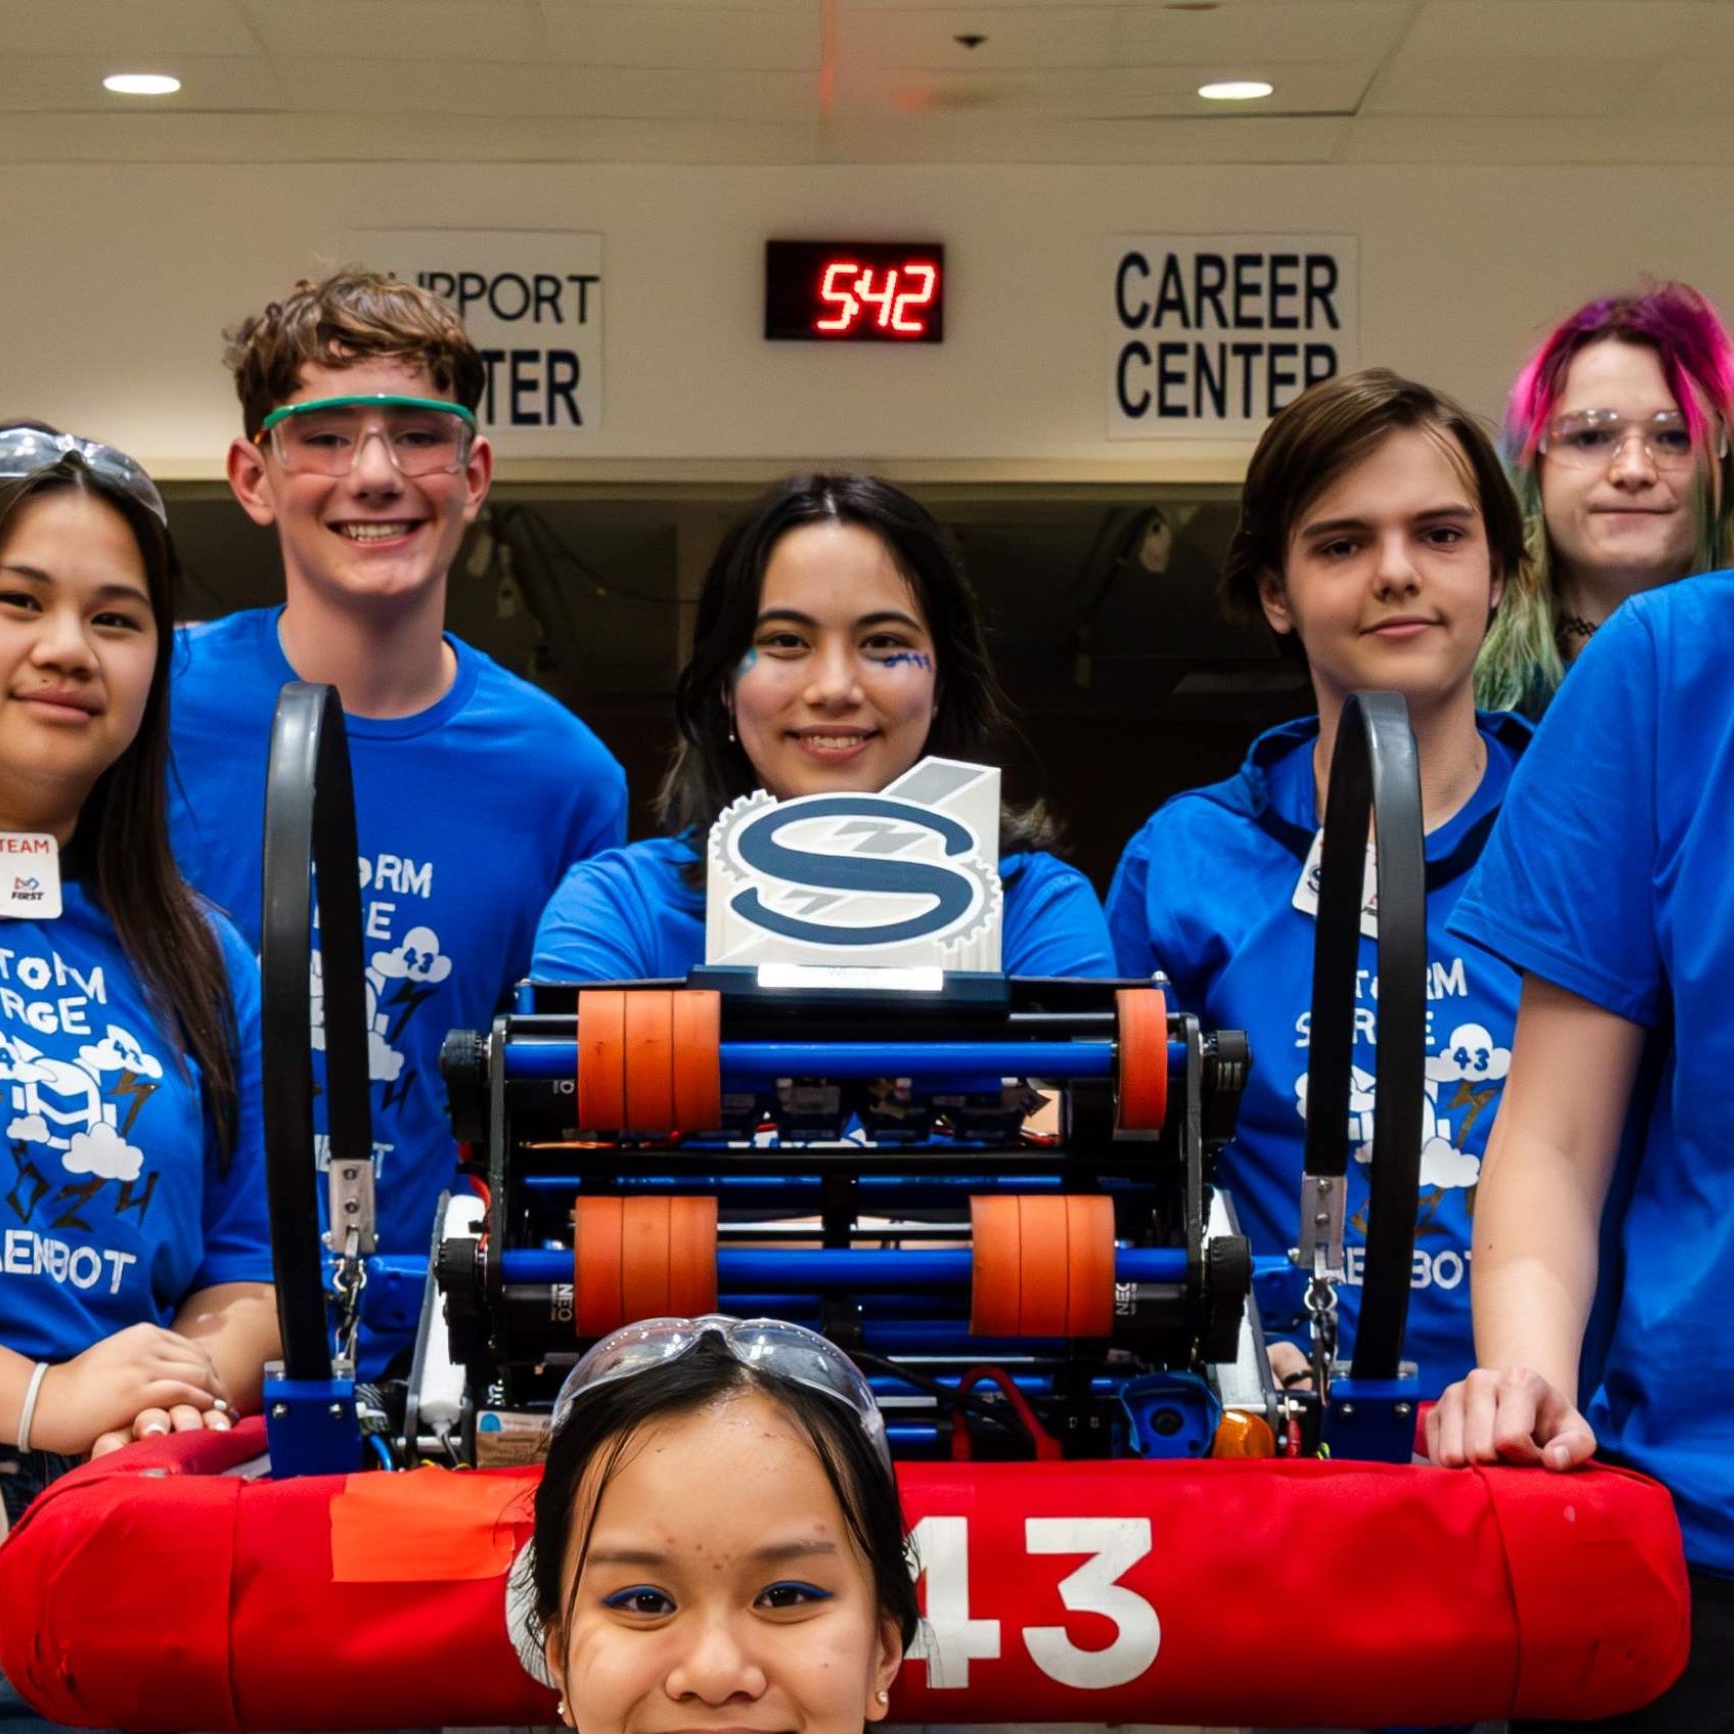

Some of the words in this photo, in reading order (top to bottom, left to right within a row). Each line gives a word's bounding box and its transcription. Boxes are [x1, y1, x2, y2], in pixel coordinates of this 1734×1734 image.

[418, 272, 601, 324] PPORT
[1115, 252, 1340, 330] CAREER
[479, 349, 583, 426] TER
[730, 797, 975, 946] S
[403, 947, 435, 974] 43
[1453, 1046, 1490, 1072] 43
[558, 1284, 574, 1321] NEO
